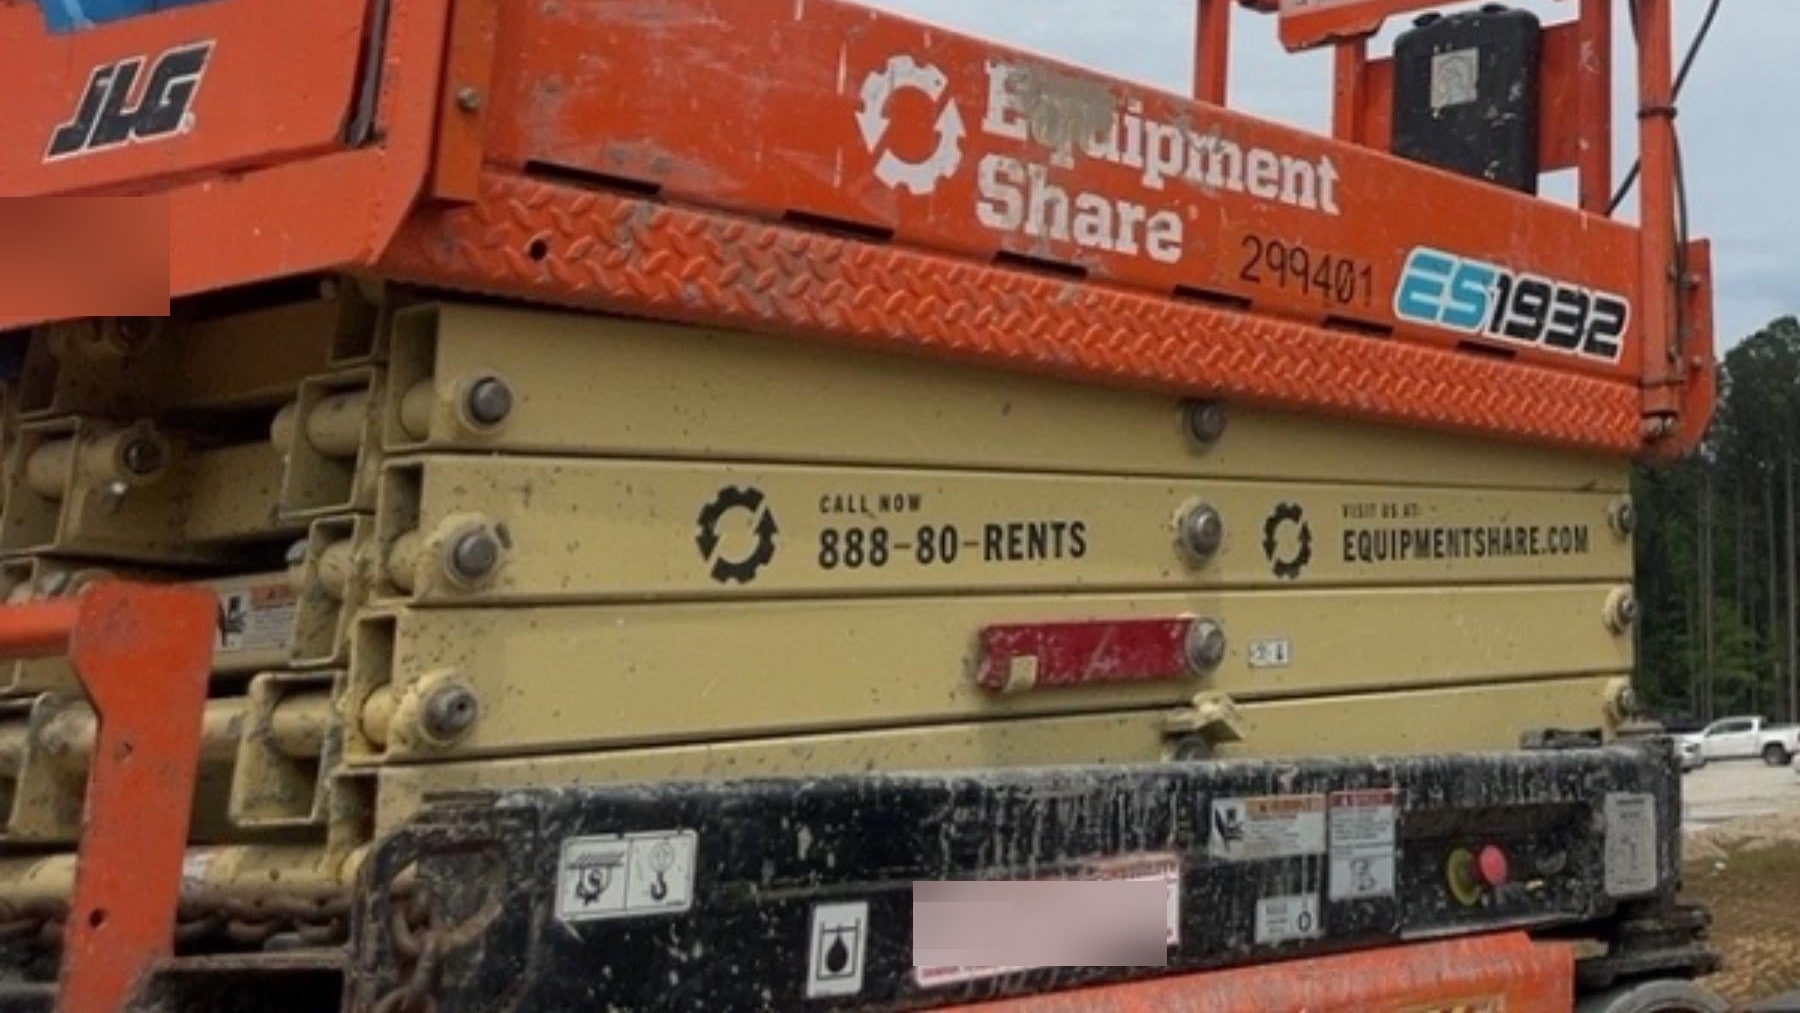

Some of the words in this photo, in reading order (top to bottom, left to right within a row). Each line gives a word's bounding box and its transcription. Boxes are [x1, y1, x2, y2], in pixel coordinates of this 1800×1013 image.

[43, 40, 215, 163] JLG
[975, 152, 1185, 264] Share
[1239, 234, 1373, 306] 299401
[819, 494, 872, 514] CALL
[878, 493, 922, 513] NOW
[818, 520, 1088, 570] 888-80-RENTS
[1342, 524, 1590, 563] EQUIPMENTSHARE.COM
